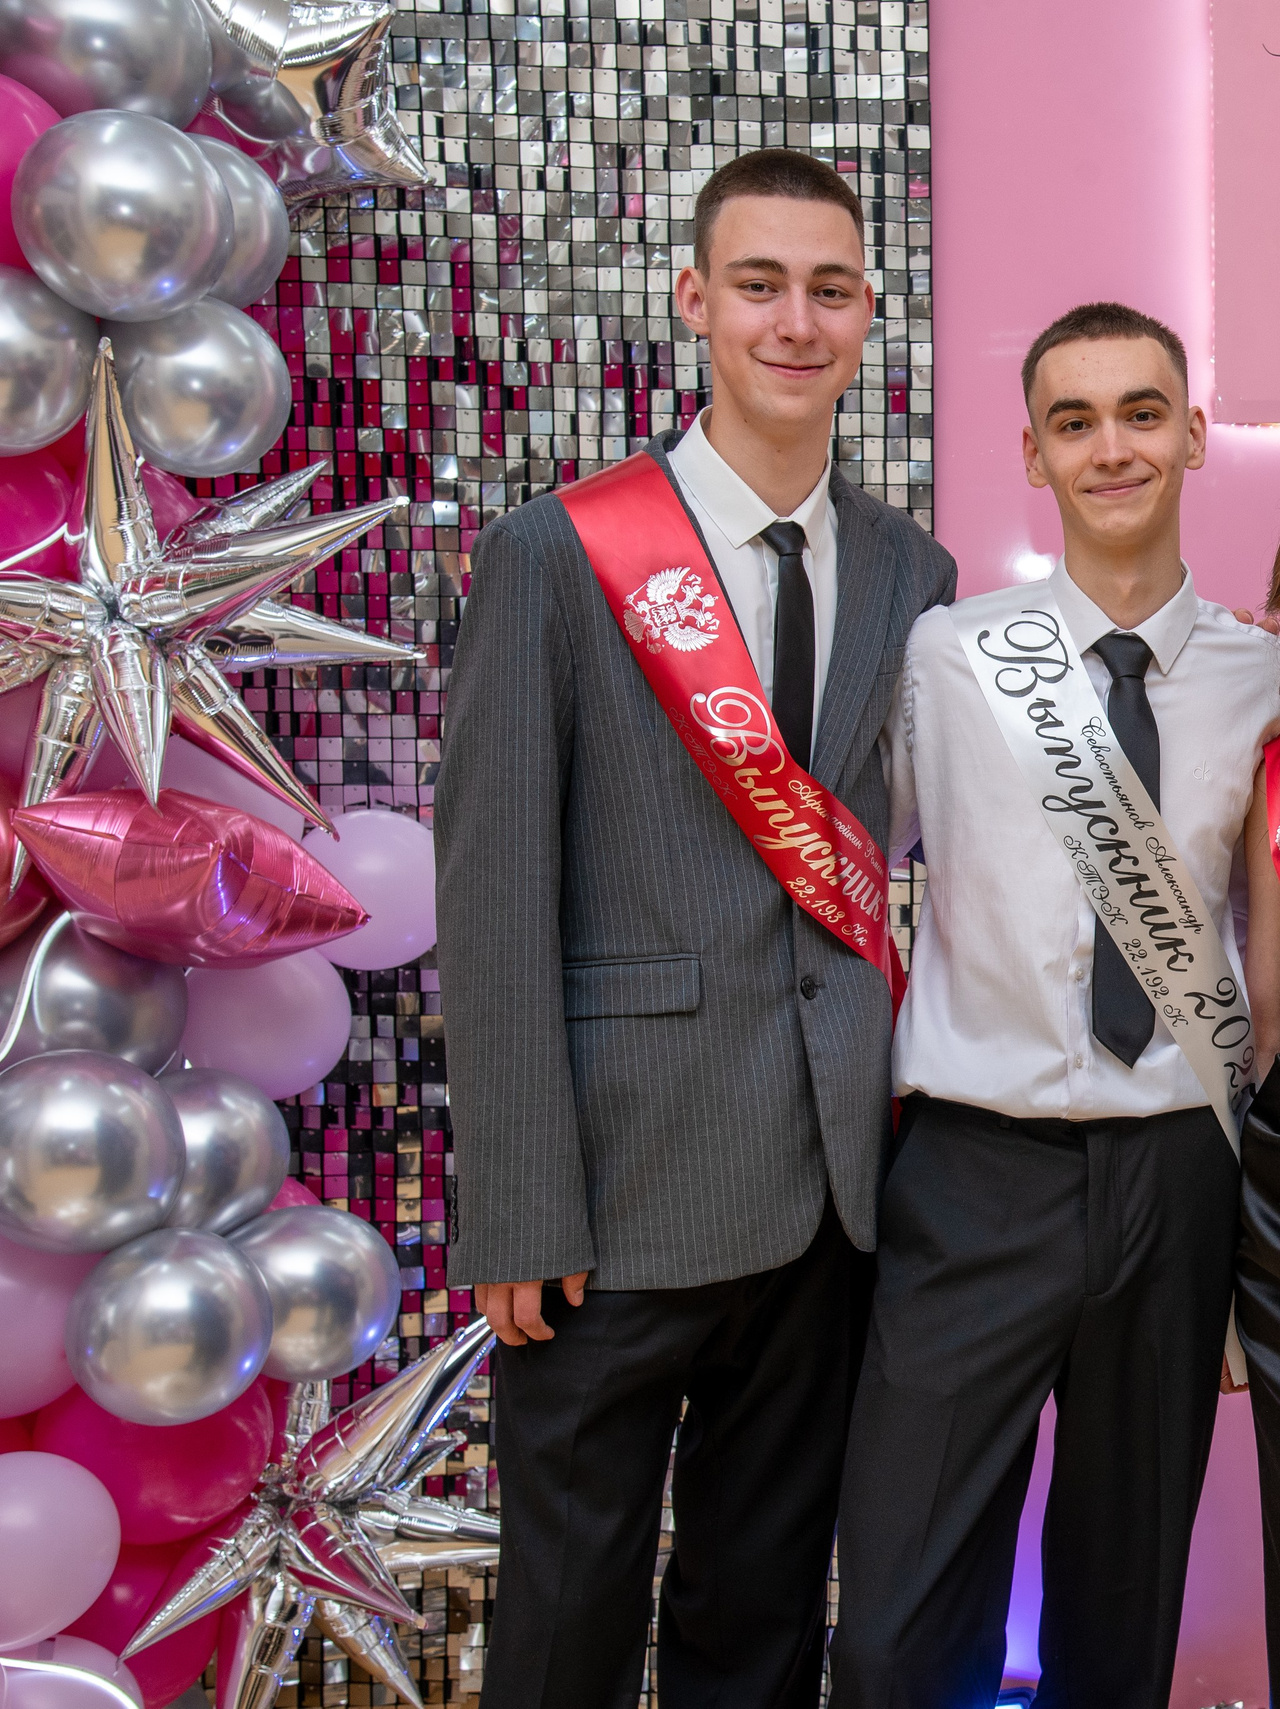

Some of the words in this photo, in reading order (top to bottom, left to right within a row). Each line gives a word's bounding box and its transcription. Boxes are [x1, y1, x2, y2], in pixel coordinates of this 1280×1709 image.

[669, 706, 738, 800] КТЭК
[786, 876, 845, 924] 22.193
[690, 686, 884, 922] Выпускник
[977, 609, 1195, 972] Выпускник
[1081, 716, 1155, 831] Севостьянов
[1145, 836, 1206, 934] Александр
[1063, 835, 1129, 926] КТЭК
[1122, 938, 1170, 999] 22.192
[1163, 1004, 1189, 1027] К
